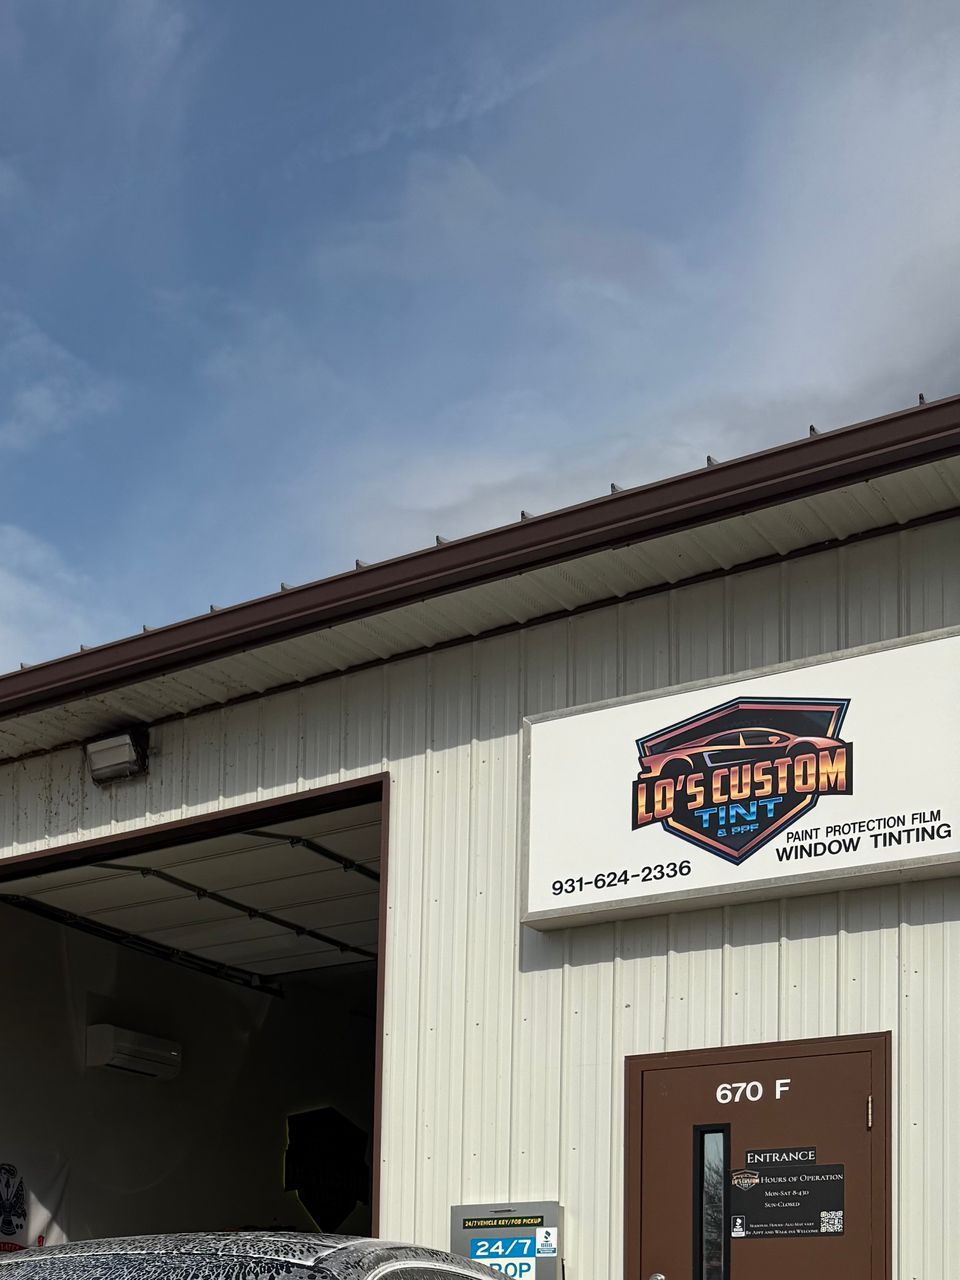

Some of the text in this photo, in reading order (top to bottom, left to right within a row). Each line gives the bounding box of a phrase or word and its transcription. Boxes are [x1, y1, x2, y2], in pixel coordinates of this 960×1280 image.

[637, 747, 847, 825] LO'S CUSTOM
[694, 797, 783, 828] TINT
[786, 809, 941, 844] PAINT PROTECTION FILM
[717, 823, 759, 838] & PPF
[775, 823, 952, 862] WINDOW TINTING
[551, 860, 692, 896] 931-624-2336
[716, 1078, 791, 1104] 670 F
[746, 1150, 816, 1164] ENTRANCE
[475, 1238, 532, 1256] 24/7
